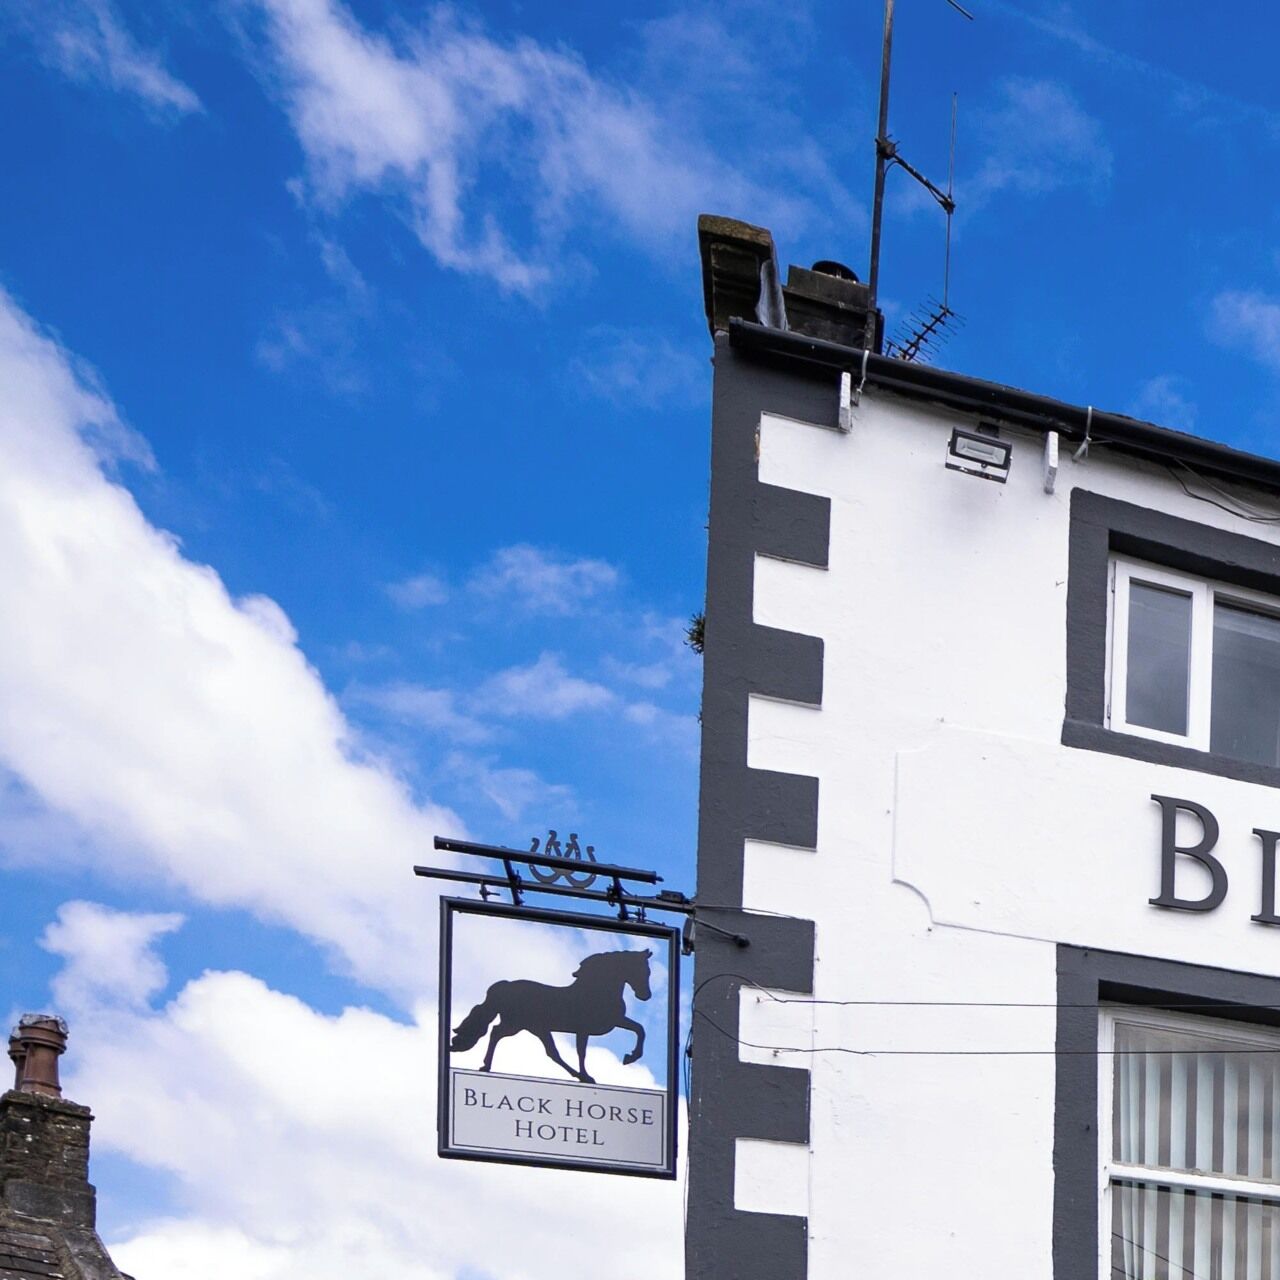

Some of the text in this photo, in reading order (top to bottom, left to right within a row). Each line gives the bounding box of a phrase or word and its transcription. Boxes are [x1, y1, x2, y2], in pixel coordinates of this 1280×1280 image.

[464, 1088, 654, 1126] BLACK HORSE
[515, 1119, 604, 1146] HOTEL
